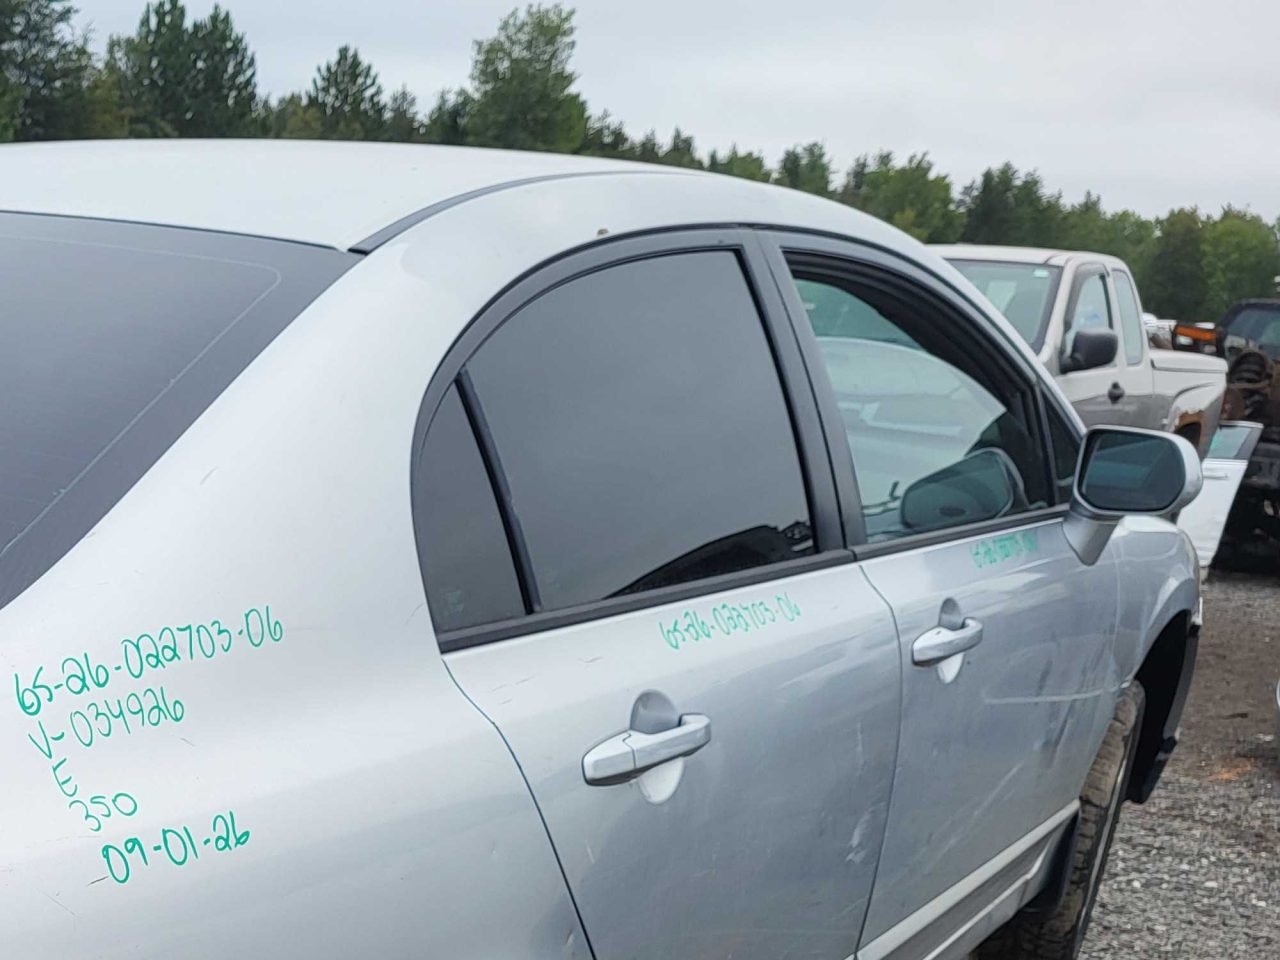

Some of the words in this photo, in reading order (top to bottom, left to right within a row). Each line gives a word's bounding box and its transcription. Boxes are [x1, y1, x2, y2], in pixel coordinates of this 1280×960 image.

[14, 604, 284, 716] 65-26-022703-06
[68, 792, 138, 832] 350
[101, 810, 251, 884] 09-01-26
